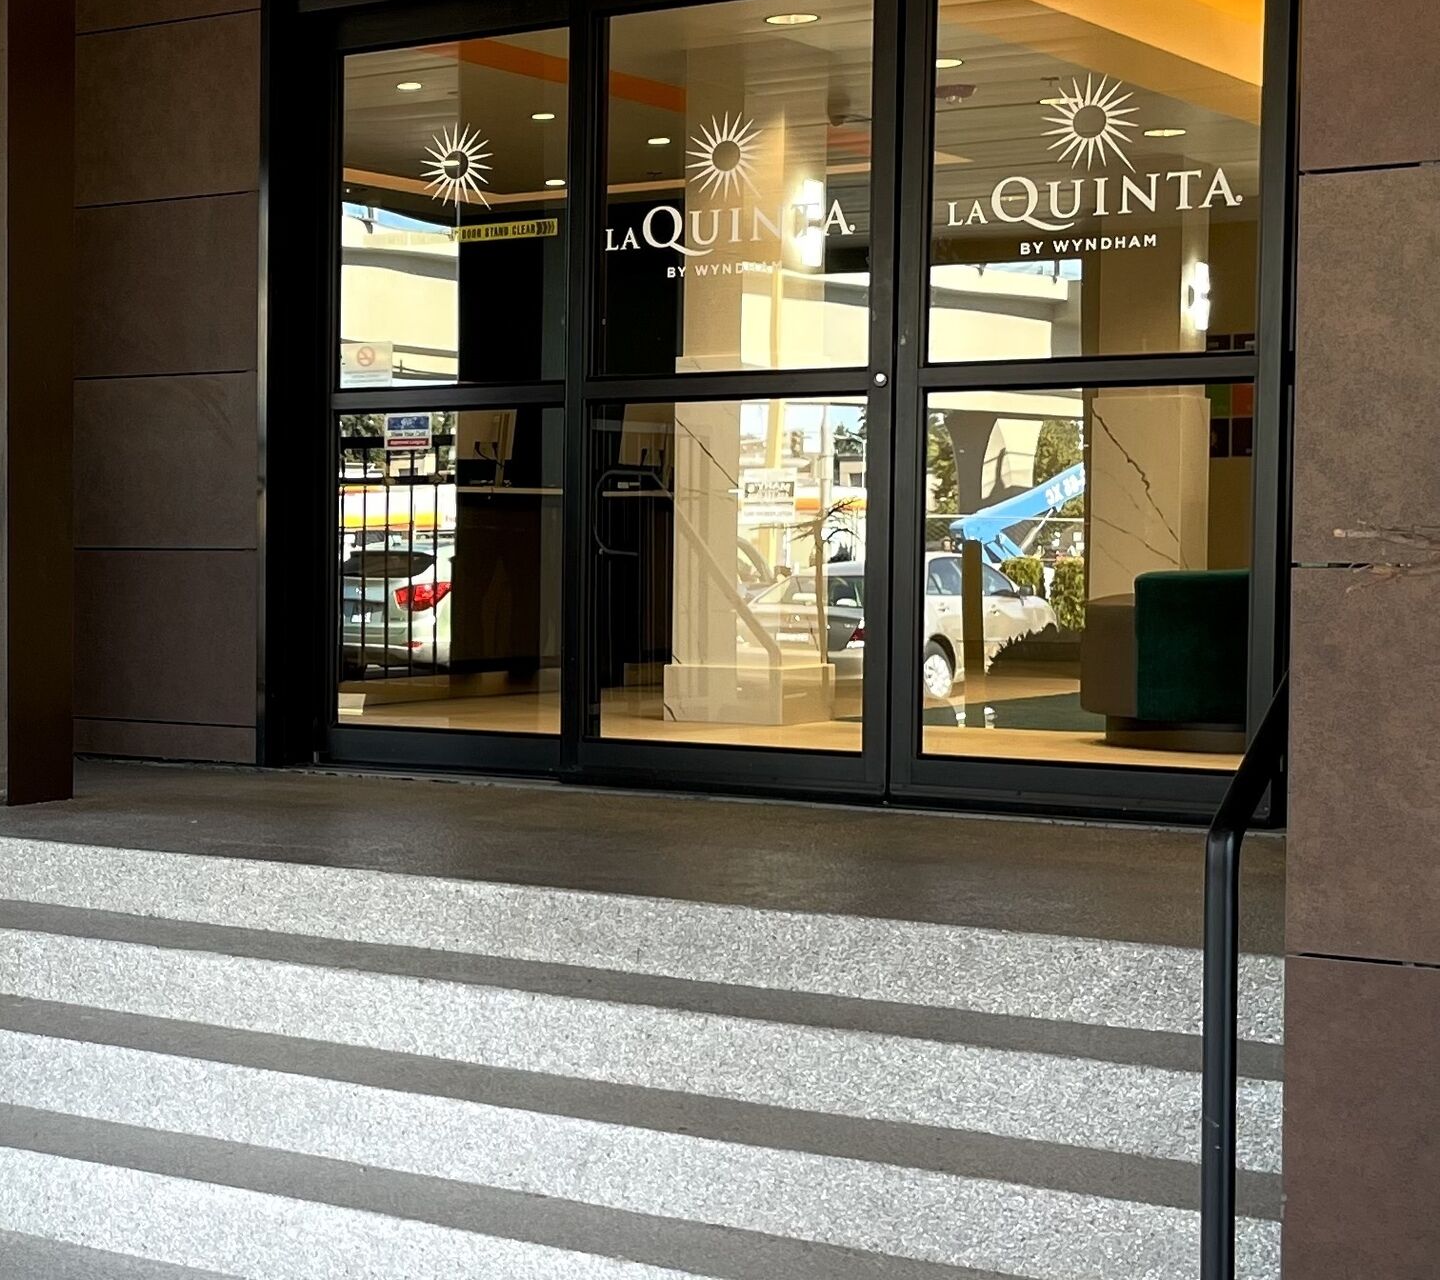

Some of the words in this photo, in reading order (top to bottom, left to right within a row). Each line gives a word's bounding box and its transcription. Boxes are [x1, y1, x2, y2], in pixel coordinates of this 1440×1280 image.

[947, 200, 989, 227] LA
[991, 168, 1240, 231] QUINTA
[484, 226, 509, 238] STAND
[511, 223, 536, 235] CLEAR
[605, 227, 641, 251] LA
[1020, 241, 1044, 255] BY
[1053, 234, 1158, 253] WYNDHAM
[667, 266, 687, 278] BY
